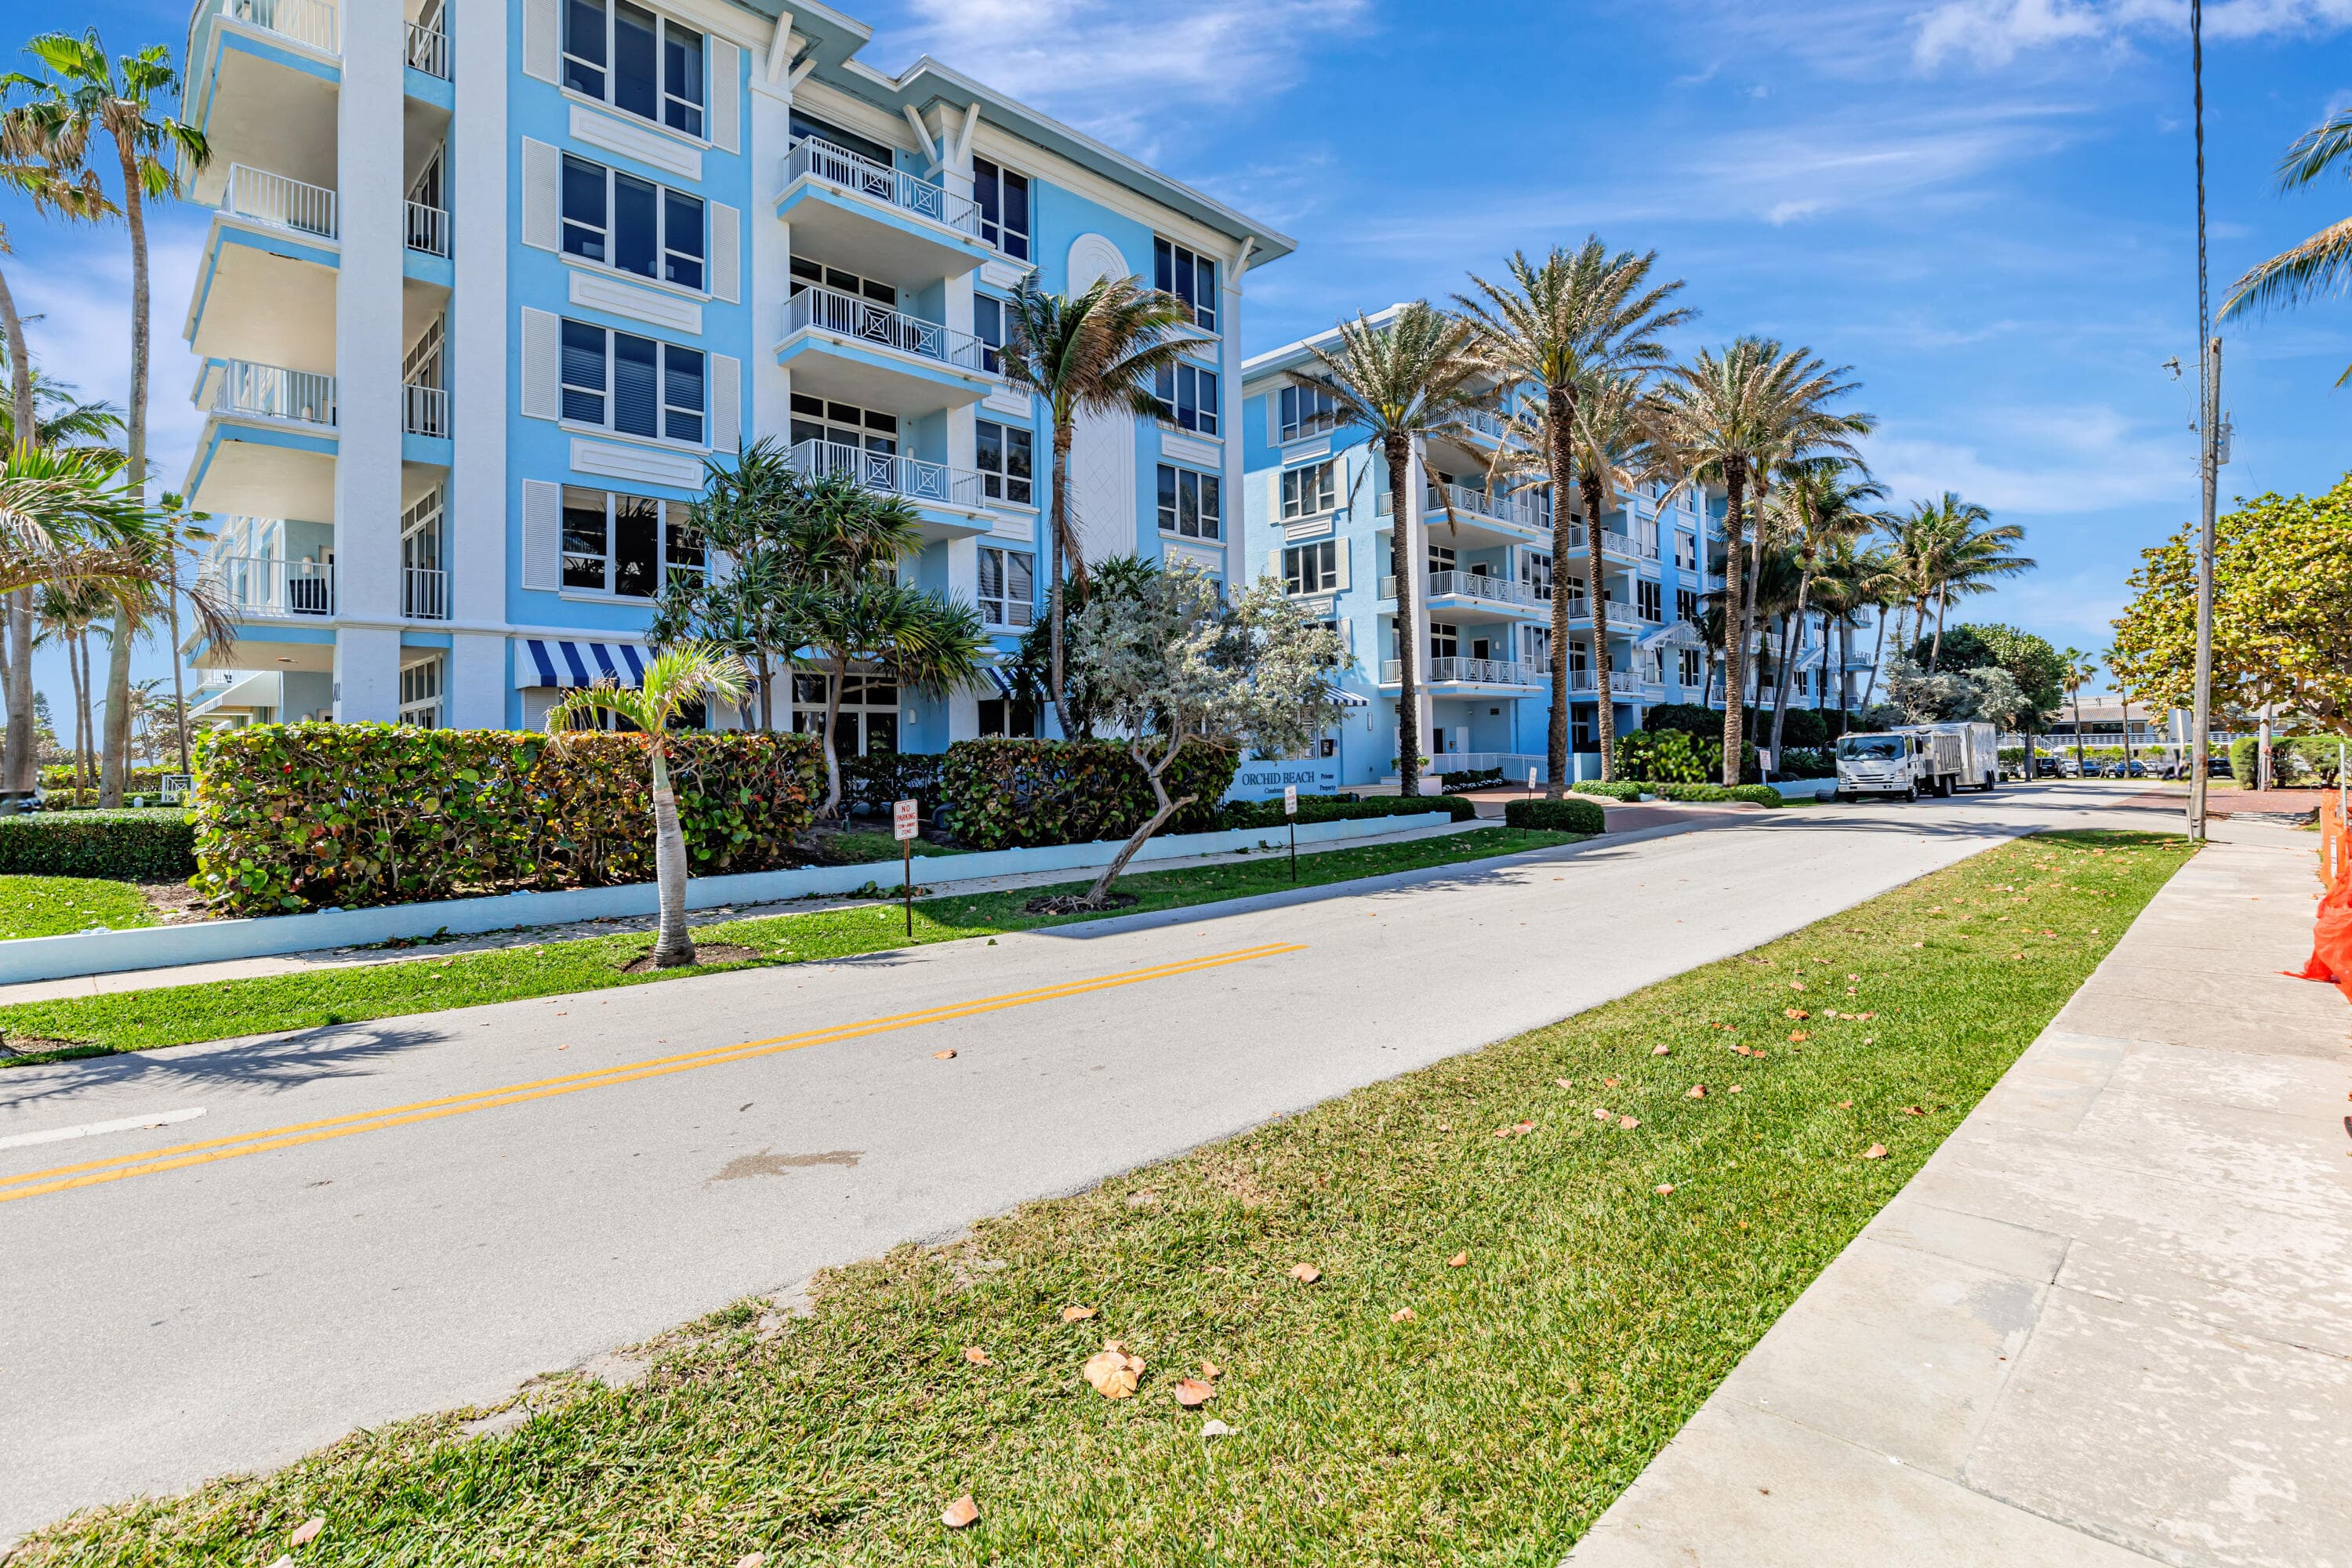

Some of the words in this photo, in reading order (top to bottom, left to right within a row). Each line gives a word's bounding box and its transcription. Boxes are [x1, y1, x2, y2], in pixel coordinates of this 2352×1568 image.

[1242, 773, 1281, 786] ORCHID
[1283, 771, 1315, 784] BEACH
[896, 811, 916, 822] PARKING
